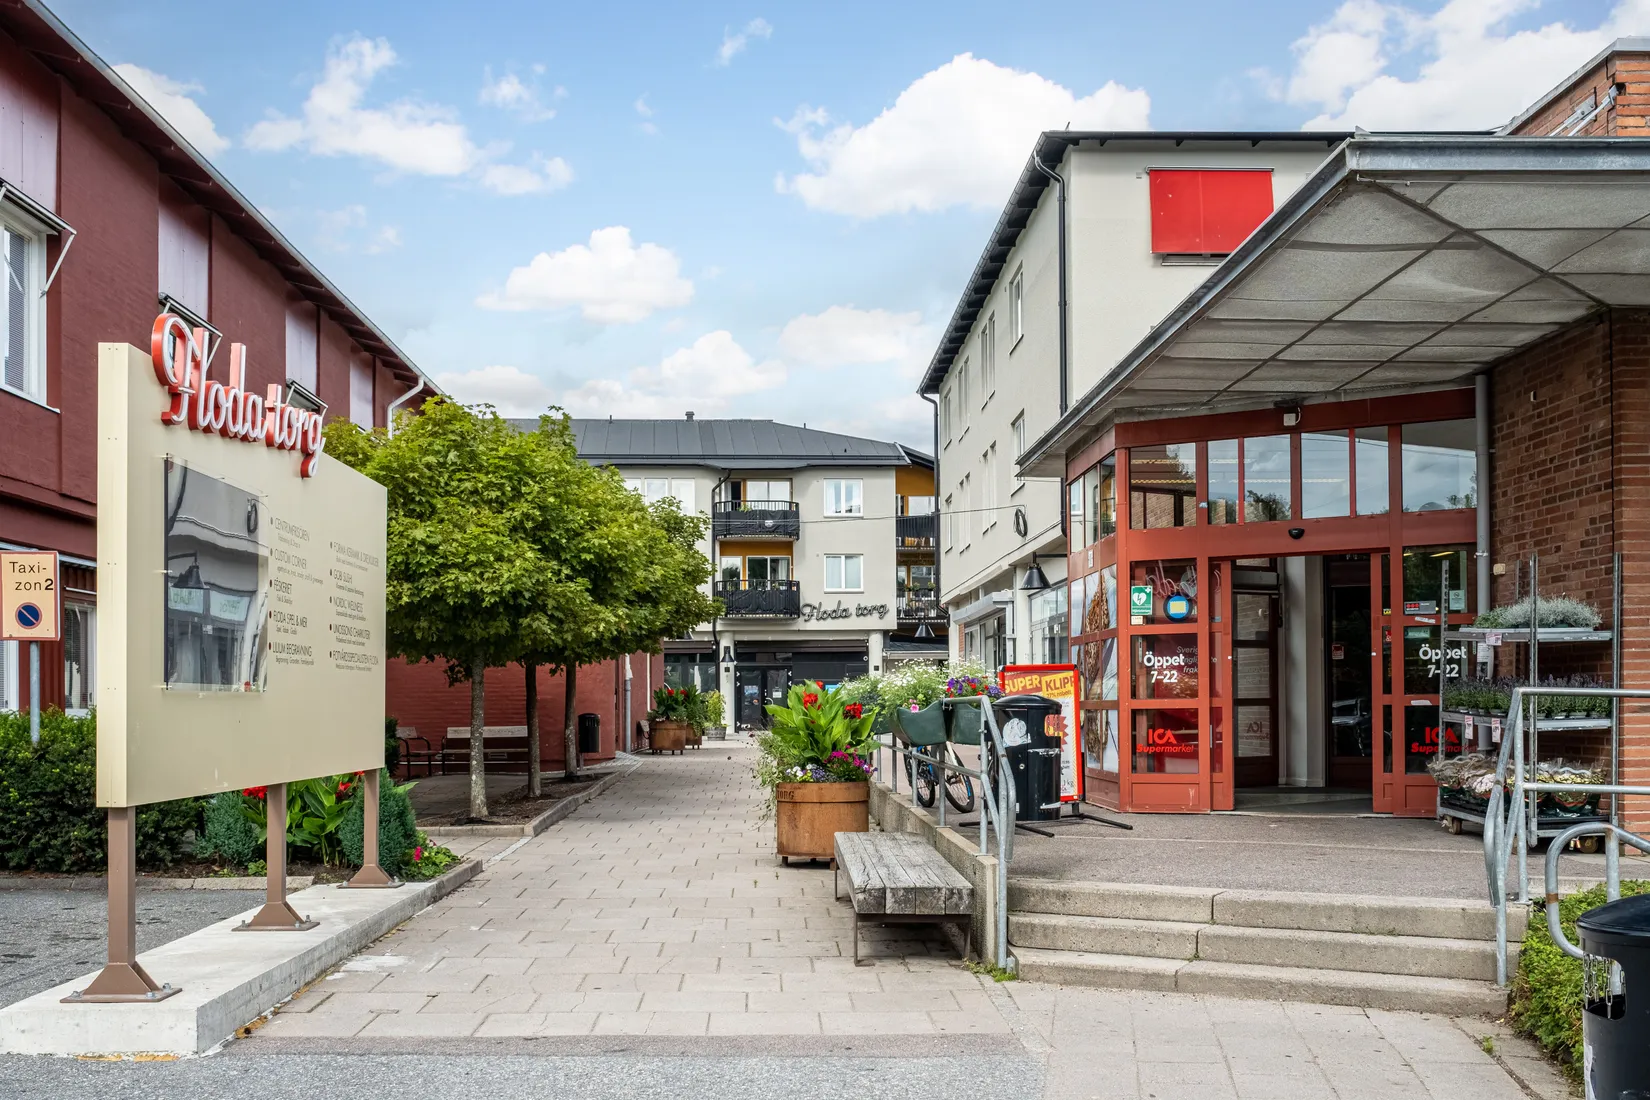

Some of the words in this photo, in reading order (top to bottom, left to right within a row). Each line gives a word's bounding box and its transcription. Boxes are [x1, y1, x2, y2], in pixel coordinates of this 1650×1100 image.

[151, 313, 266, 442] Floda
[264, 383, 326, 479] torg
[9, 561, 47, 574] Taxi-
[800, 600, 852, 623] Floda
[855, 601, 890, 620] torg
[1144, 652, 1185, 668] Öppet
[1148, 728, 1177, 744] ICA
[1136, 744, 1194, 754] Supermarket
